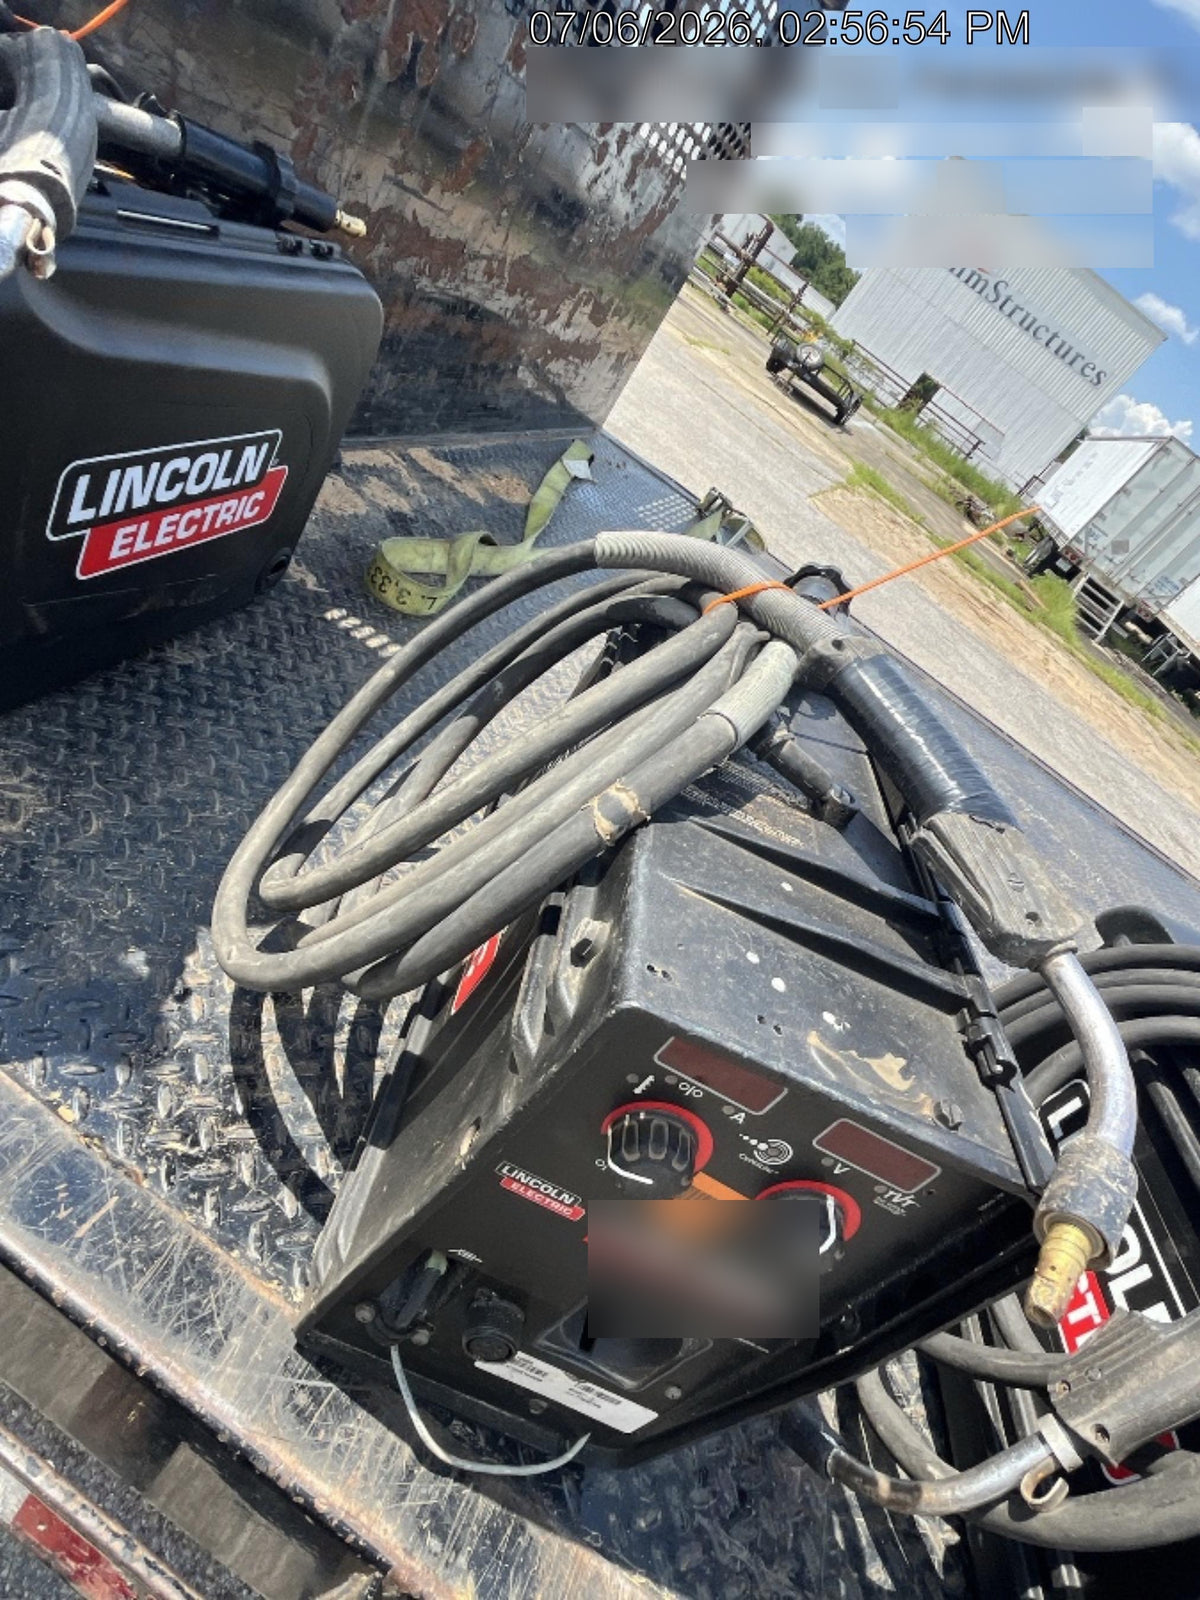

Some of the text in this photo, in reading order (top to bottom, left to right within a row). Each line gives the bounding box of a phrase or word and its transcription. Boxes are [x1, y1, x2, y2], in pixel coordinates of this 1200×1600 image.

[66, 441, 270, 525] LINCOLN
[108, 491, 265, 561] ELECTRIC
[500, 1164, 575, 1205] LINCOLN
[510, 1182, 574, 1216] ELECTRIC
